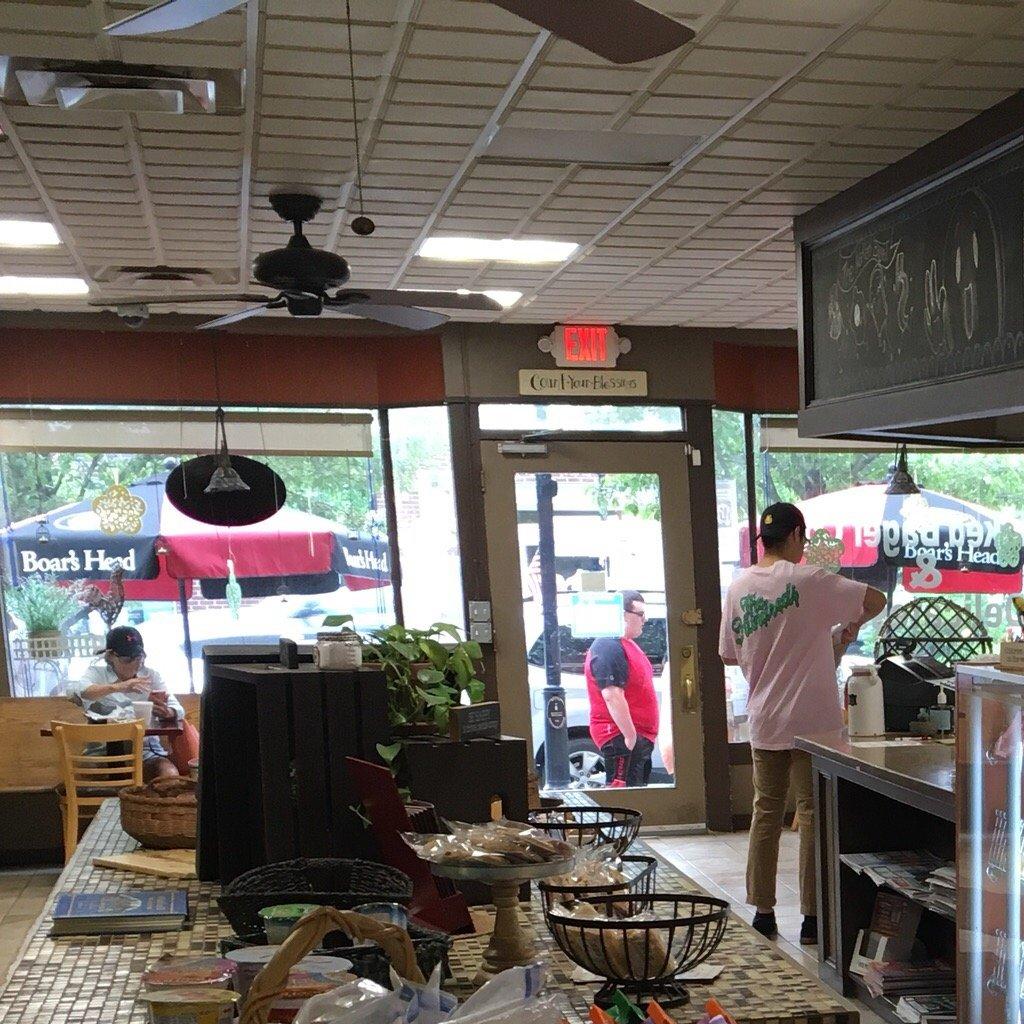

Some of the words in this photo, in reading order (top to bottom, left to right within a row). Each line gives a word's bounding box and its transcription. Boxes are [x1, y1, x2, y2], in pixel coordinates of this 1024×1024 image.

[564, 327, 608, 362] EXIT
[21, 548, 81, 572] Boar's
[957, 545, 1002, 566] Head
